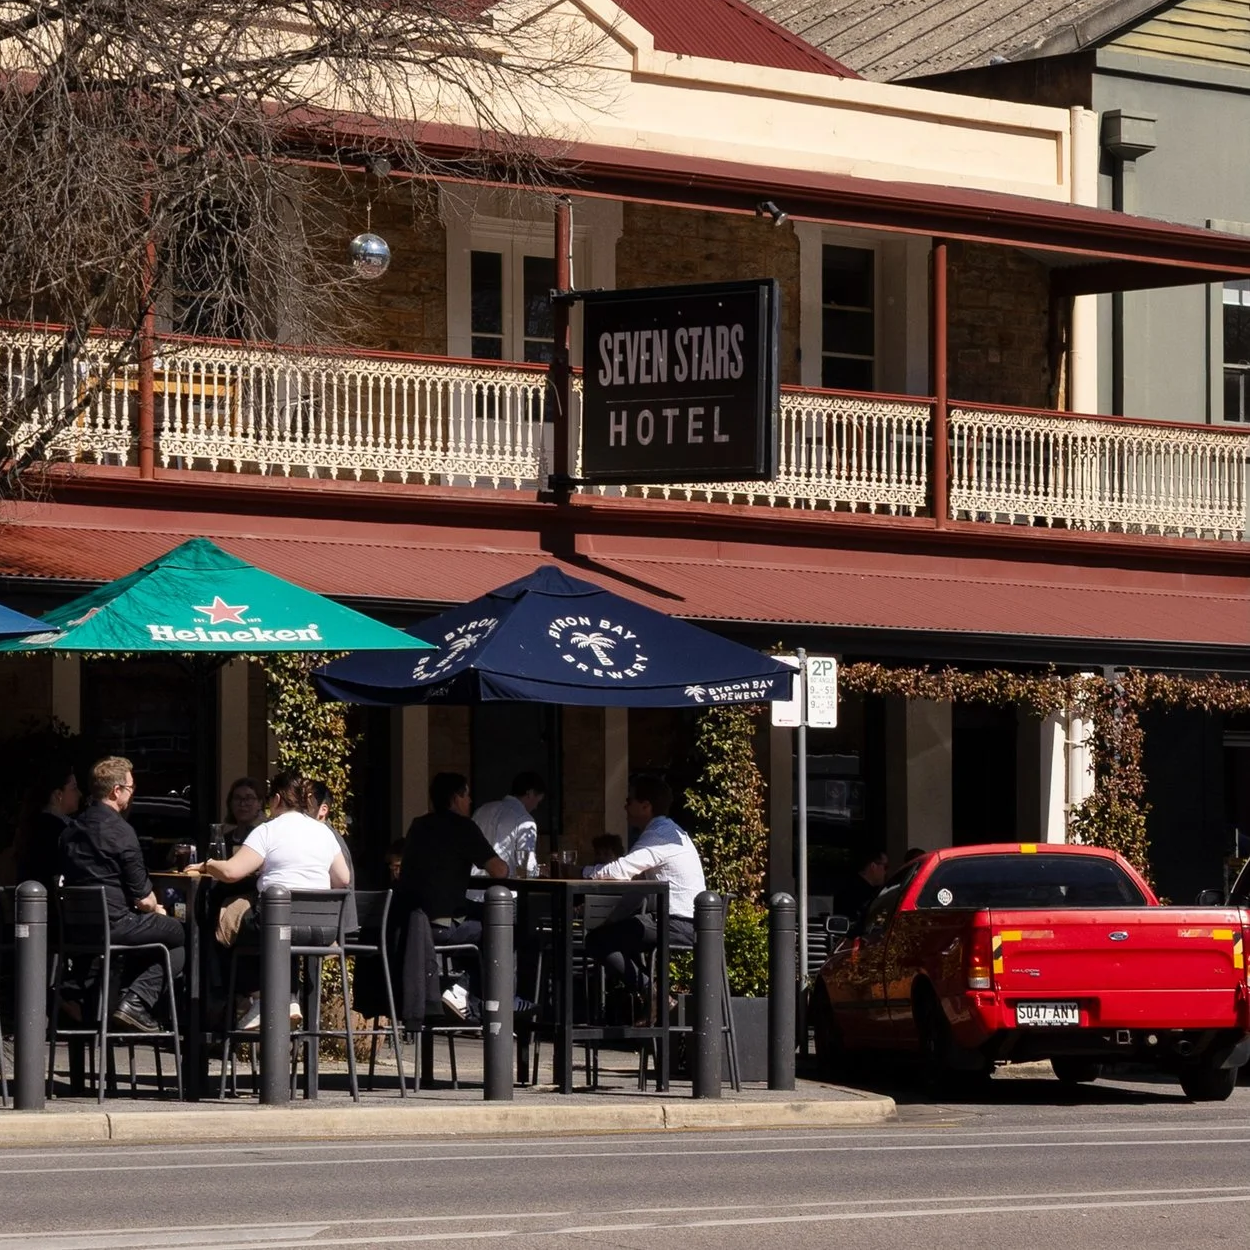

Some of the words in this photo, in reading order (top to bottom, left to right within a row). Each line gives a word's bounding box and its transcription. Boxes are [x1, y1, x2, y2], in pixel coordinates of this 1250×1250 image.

[598, 329, 668, 386] SEVEN
[674, 323, 744, 382] STARS
[609, 406, 730, 447] HOTEL
[147, 624, 323, 643] Heineken
[549, 616, 591, 639] BYRON
[599, 619, 637, 640] BAY
[562, 653, 649, 680] BREWERY
[812, 660, 833, 676] 2P
[708, 682, 750, 696] BYRON
[752, 679, 774, 690] BAY
[712, 690, 766, 702] BREWERY
